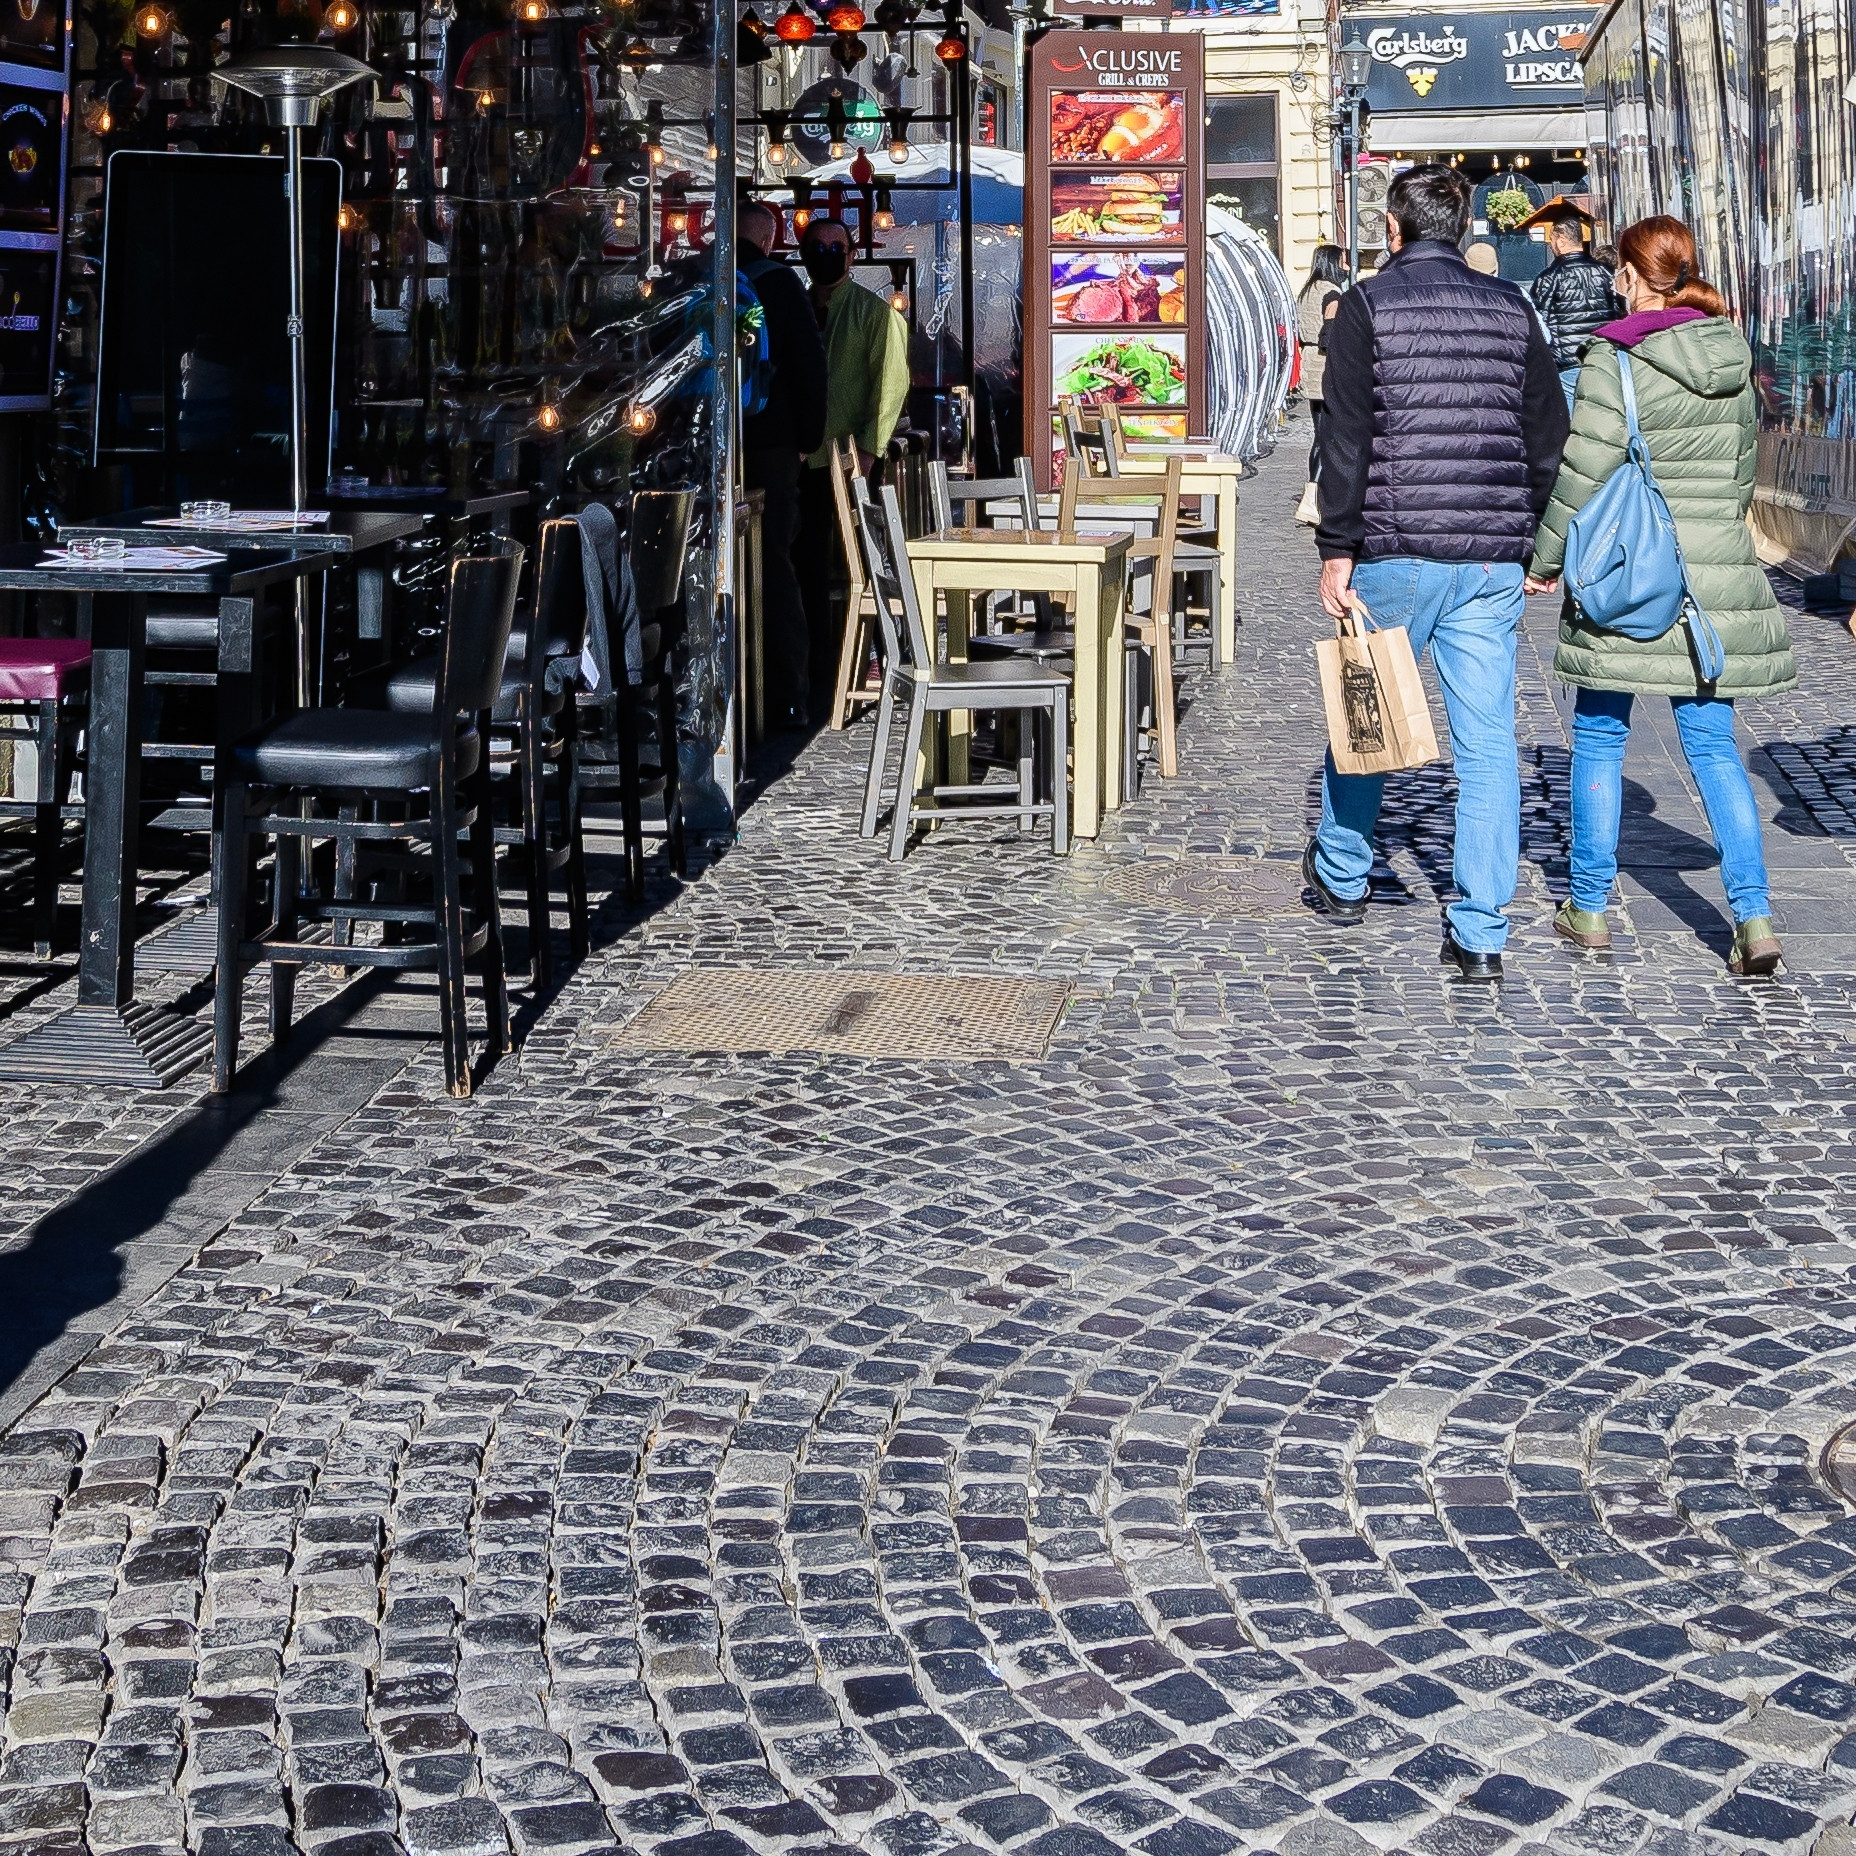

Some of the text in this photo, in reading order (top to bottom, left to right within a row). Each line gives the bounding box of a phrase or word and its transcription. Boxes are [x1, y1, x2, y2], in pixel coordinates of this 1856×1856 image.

[1368, 25, 1468, 66] Carlsberg
[1098, 73, 1126, 87] GRILL
[1135, 73, 1169, 87] CREPES
